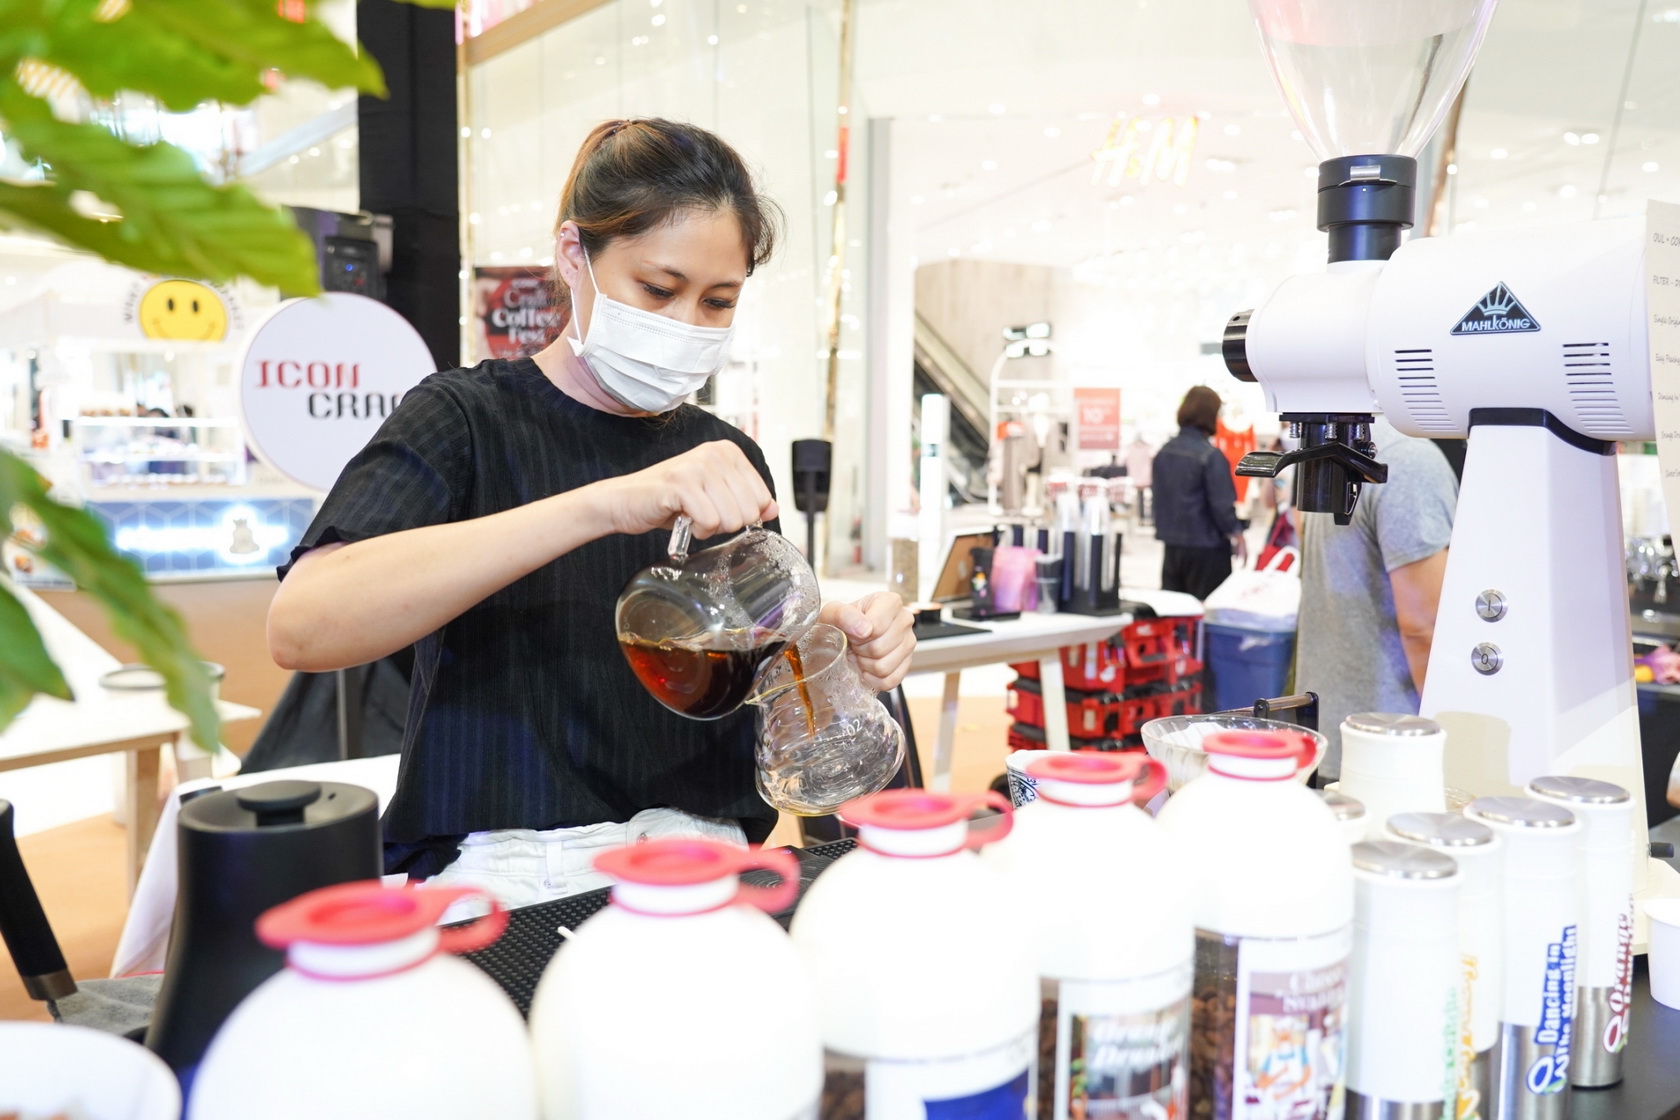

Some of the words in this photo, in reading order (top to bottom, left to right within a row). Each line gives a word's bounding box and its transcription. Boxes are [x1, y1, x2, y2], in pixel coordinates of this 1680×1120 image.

[1090, 115, 1199, 188] H&M
[254, 359, 362, 390] ICON
[1546, 945, 1561, 963] in
[1537, 969, 1562, 1043] Dancing
